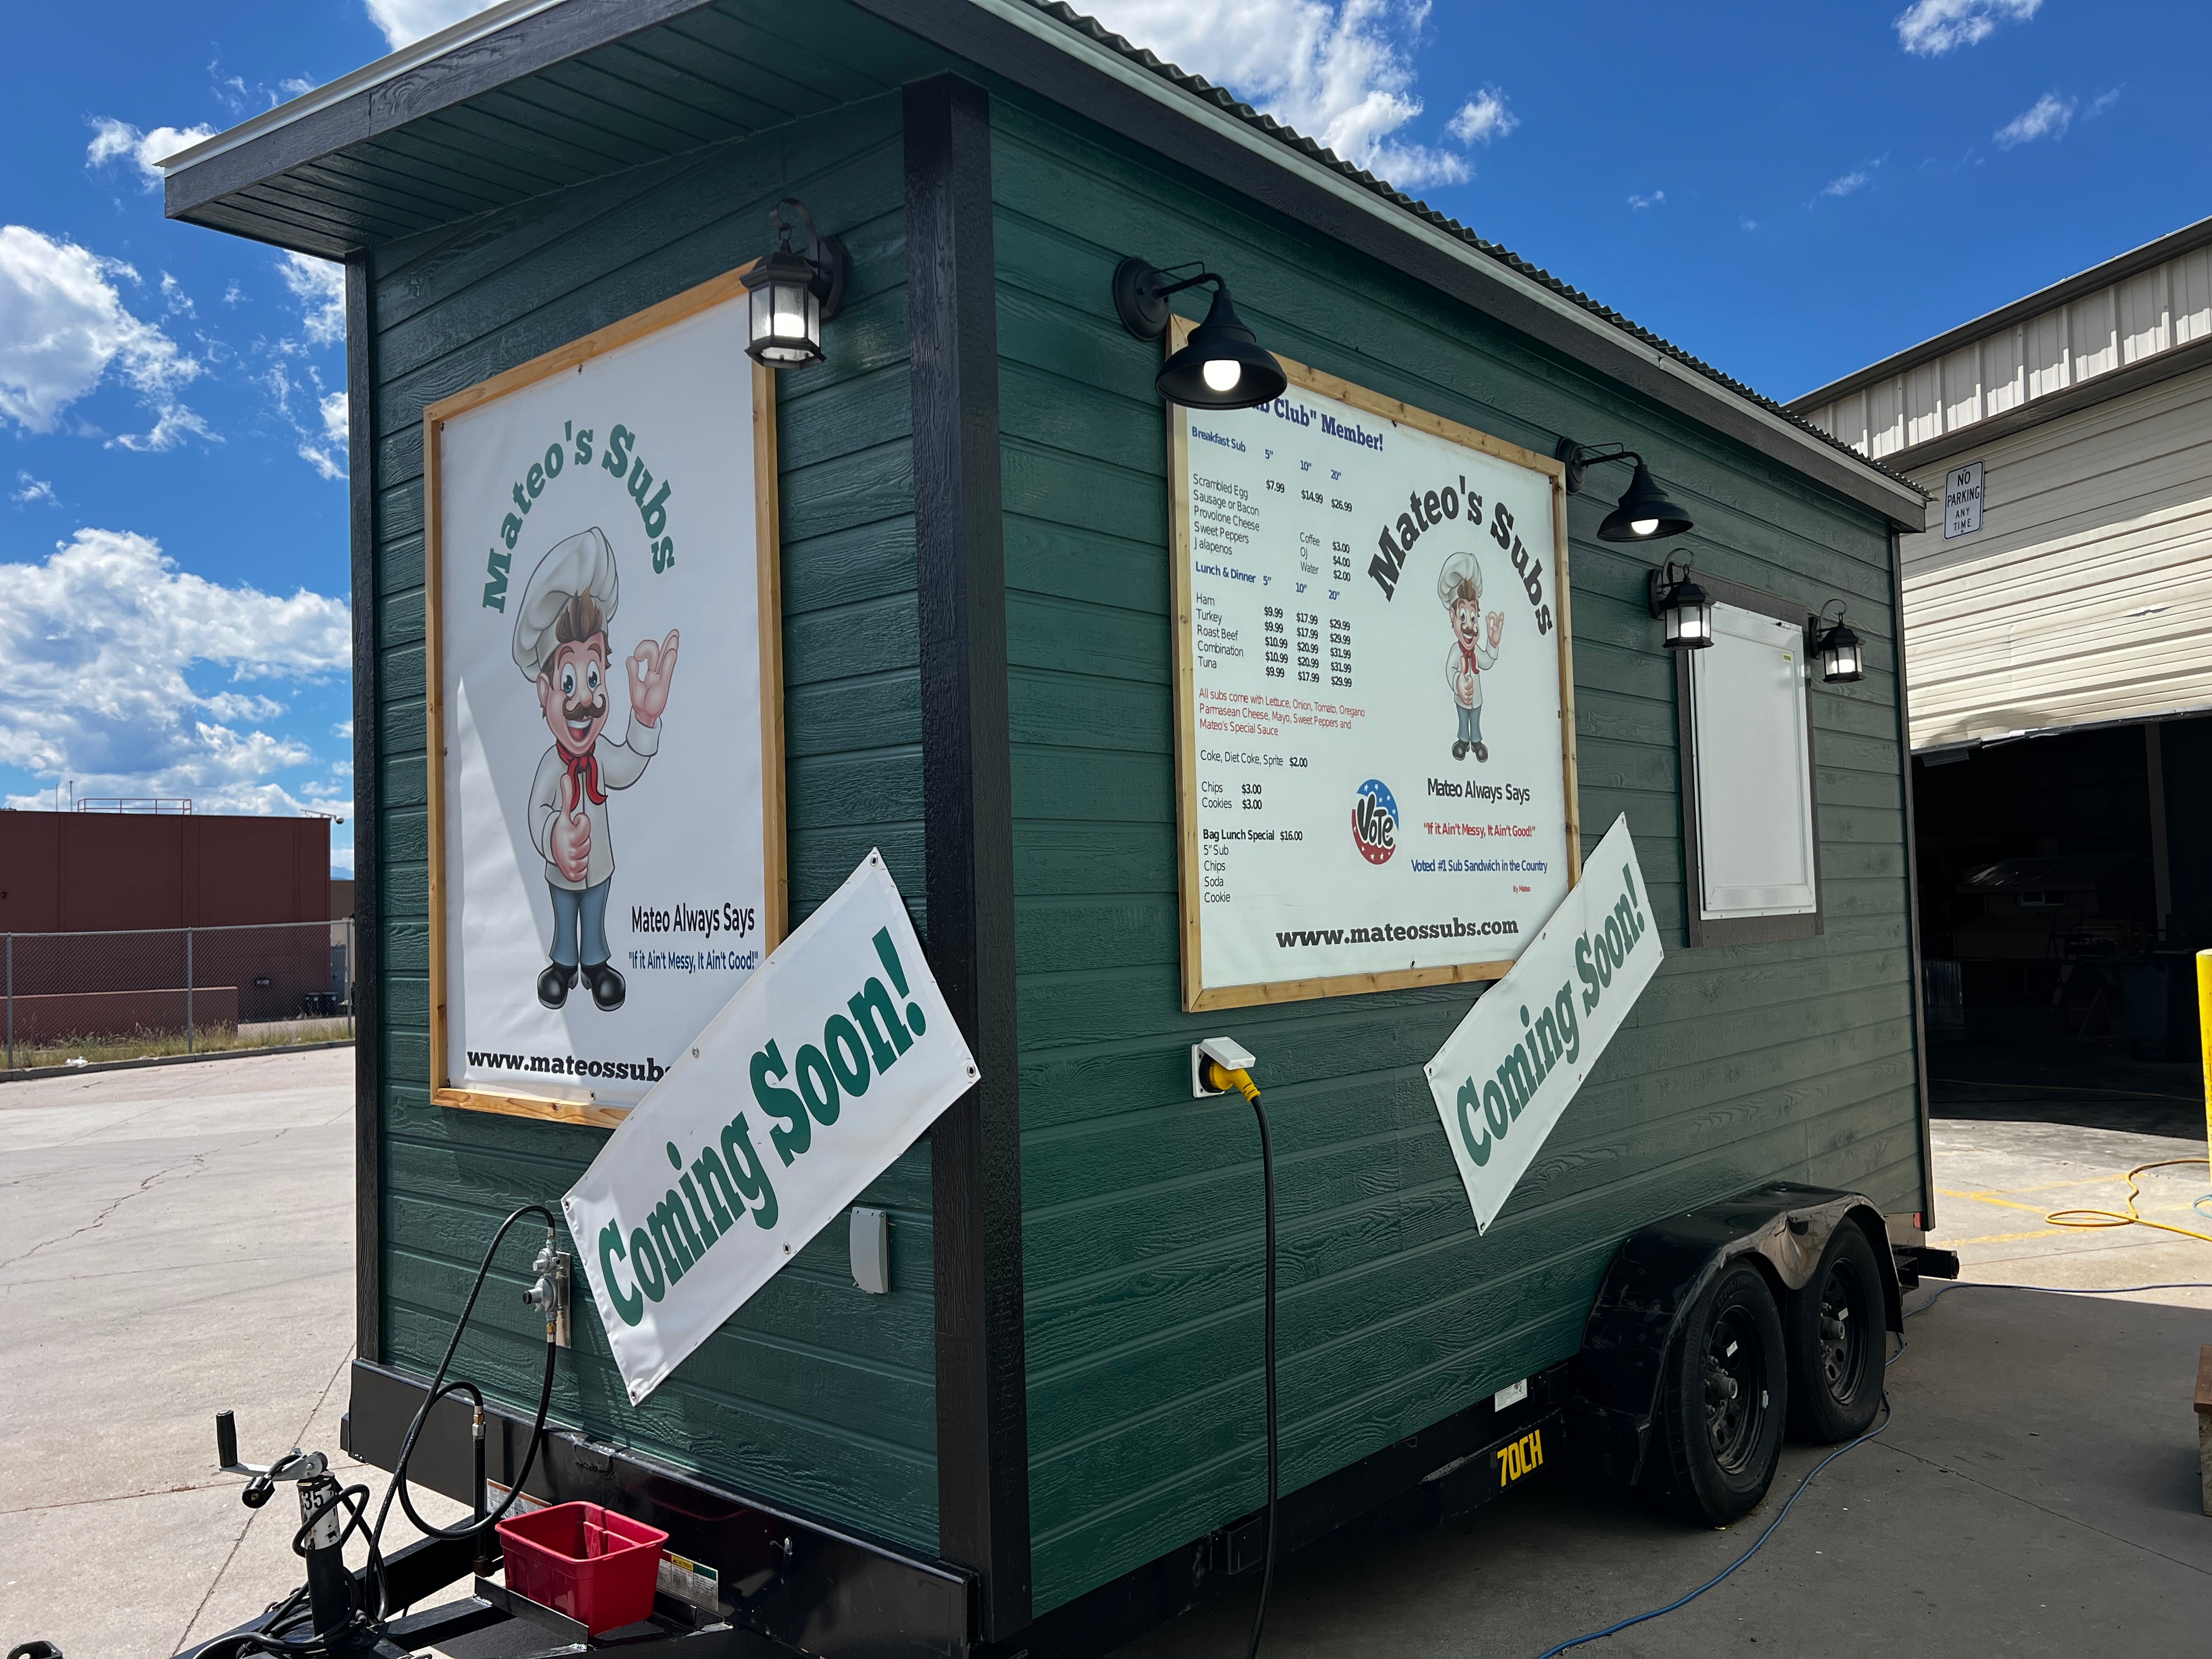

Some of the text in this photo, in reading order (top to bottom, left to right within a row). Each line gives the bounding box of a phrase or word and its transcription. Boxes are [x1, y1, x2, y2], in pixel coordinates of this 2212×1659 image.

[1274, 398, 1383, 451] Club" Member!
[1192, 426, 1229, 447] Breakfast
[1232, 438, 1245, 452] Sub
[1957, 471, 1971, 487] NO
[1193, 473, 1352, 512] Scrambled Egg $7.99 $14.99 $26.99
[1194, 490, 1259, 516] Sausage or Bacon
[1948, 486, 1980, 507] PARKING
[482, 420, 675, 614] Mateo's Subs
[1194, 505, 1260, 532] Provolone Cheese
[1955, 506, 1971, 519] ANY
[1194, 522, 1249, 544] Sweet Peppers
[1954, 518, 1971, 532] TIME
[1300, 532, 1350, 554] Coffee $3.00
[1368, 475, 1553, 635] Mateo's Subs
[1300, 547, 1350, 567] OJ $4.00
[1195, 561, 1221, 577] Lunch
[1222, 567, 1229, 577] &
[1231, 569, 1256, 584] Dinner
[1300, 561, 1351, 582] Water $2.00
[1196, 592, 1350, 631] Ham $9.99 $17.99 $29.99
[1196, 608, 1351, 646] Turkey $9.99 $17.99 $29.99
[1197, 624, 1351, 660] Roast Beef $10.99 $20.99 $31.99
[1198, 640, 1352, 674] Combination $10.99 $20.99 $31.99
[1198, 656, 1352, 688] Tuna $9.99 $17.99 $29.99
[1199, 687, 1365, 718] All subs come with Lettuce, Onion, Tomato, Oregano
[1199, 703, 1351, 730] Parmasean Cheese, Mayo, Sweet Peppers and
[1199, 718, 1279, 736] Mateo's Special Sauce
[1200, 749, 1308, 768] Coke, Diet Coke, Sprite $2.00
[1201, 781, 1262, 795] Chips $3.00
[1427, 778, 1530, 805] Mateo Always Says
[1202, 797, 1262, 810] Cookies $3.00
[1203, 829, 1303, 842] Bag Lunch Special $16.00
[1435, 823, 1441, 835] it
[1442, 823, 1461, 836] Ain't
[1462, 824, 1486, 839] Messy,
[1488, 825, 1493, 836] It
[1494, 825, 1511, 837] Ain't
[1214, 844, 1229, 855] Sub
[1204, 860, 1226, 873] Chips
[1412, 859, 1548, 874] Voted #1 Sub Sandwich in the Country
[1204, 876, 1224, 887] Soda
[1204, 891, 1231, 903] Cookie
[631, 902, 755, 938] Mateo Always Says
[1276, 917, 1518, 947] www.mateossubs.com
[629, 950, 758, 974] "If it Ain't Messy, It Ain't Good!"
[1457, 862, 1645, 1167] Coming Soon!
[467, 1051, 672, 1082] www.mateossub
[598, 926, 926, 1327] Coming Soon!
